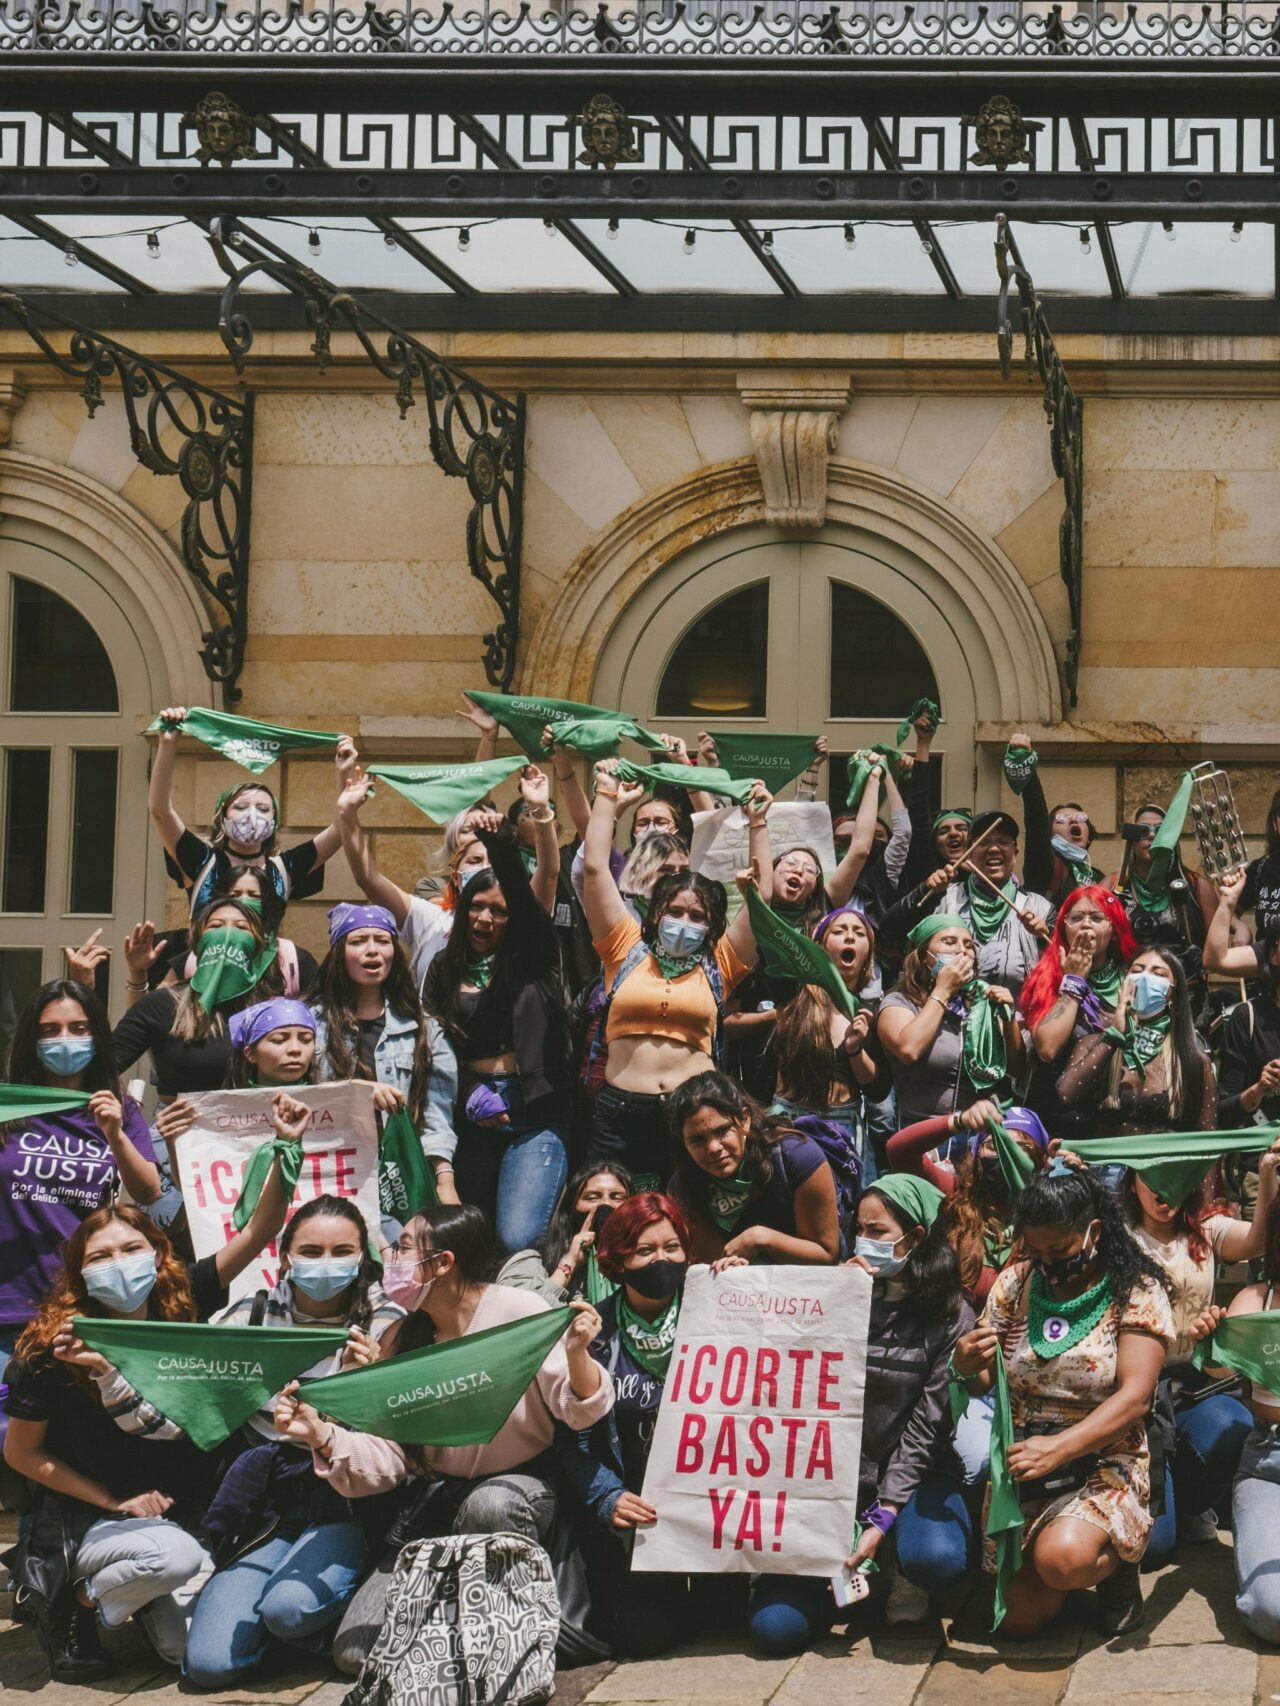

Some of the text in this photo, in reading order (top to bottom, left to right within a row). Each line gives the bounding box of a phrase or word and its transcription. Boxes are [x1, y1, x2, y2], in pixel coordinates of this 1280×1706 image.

[19, 1132, 114, 1160] CAUSA
[11, 1182, 33, 1191] Por
[36, 1184, 46, 1194] la
[13, 1155, 114, 1185] JUSTA
[384, 1161, 409, 1210] ABORTO
[11, 1190, 28, 1200] del
[31, 1192, 59, 1204] delito
[78, 1197, 98, 1209] abo
[671, 1344, 844, 1410] ¡CORTE
[675, 1413, 834, 1480] BASTA
[709, 1488, 787, 1552] YA!
